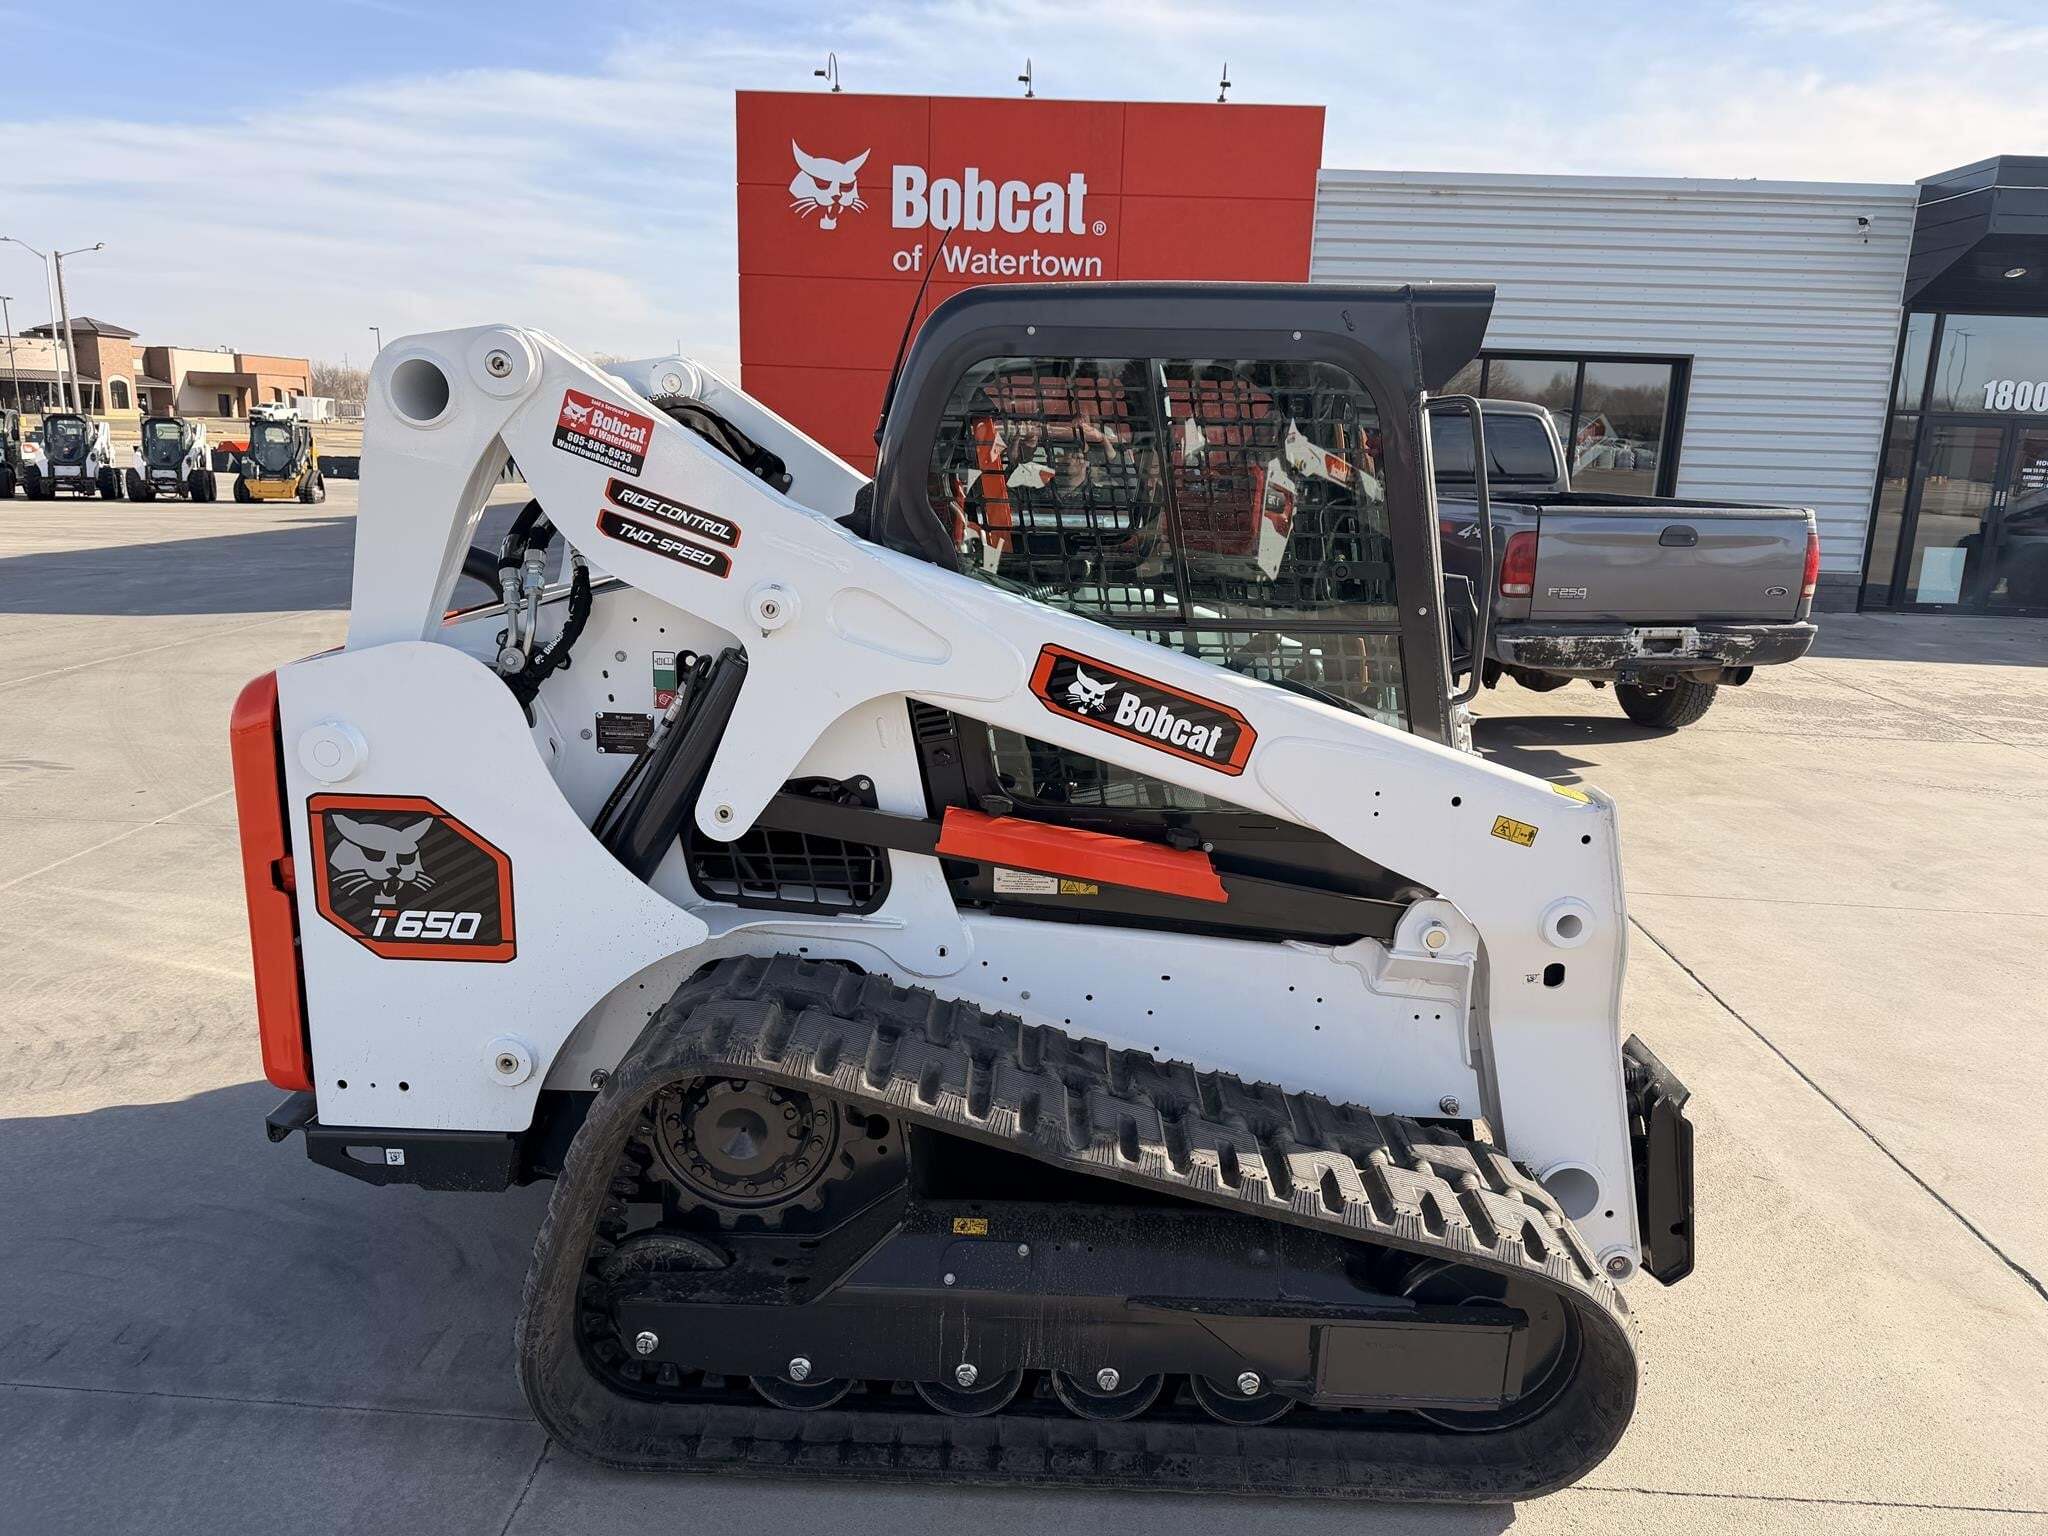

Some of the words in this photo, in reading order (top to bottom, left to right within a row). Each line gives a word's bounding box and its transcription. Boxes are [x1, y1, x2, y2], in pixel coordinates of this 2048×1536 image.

[892, 165, 1087, 235] Bobcat
[893, 244, 922, 272] of
[941, 245, 1102, 276] Watertown
[1983, 380, 2048, 412] 1800
[589, 427, 597, 436] of
[599, 430, 642, 453] Watertown
[591, 409, 646, 444] Bobcat
[557, 438, 638, 475] WatertownBobcat.com
[567, 432, 632, 463] 605-886-6933
[617, 489, 657, 511] RIDE
[656, 504, 731, 540] CONTROL
[619, 523, 716, 566] TWO-SPEED
[1113, 691, 1223, 757] Bobcat
[370, 909, 482, 940] T650
